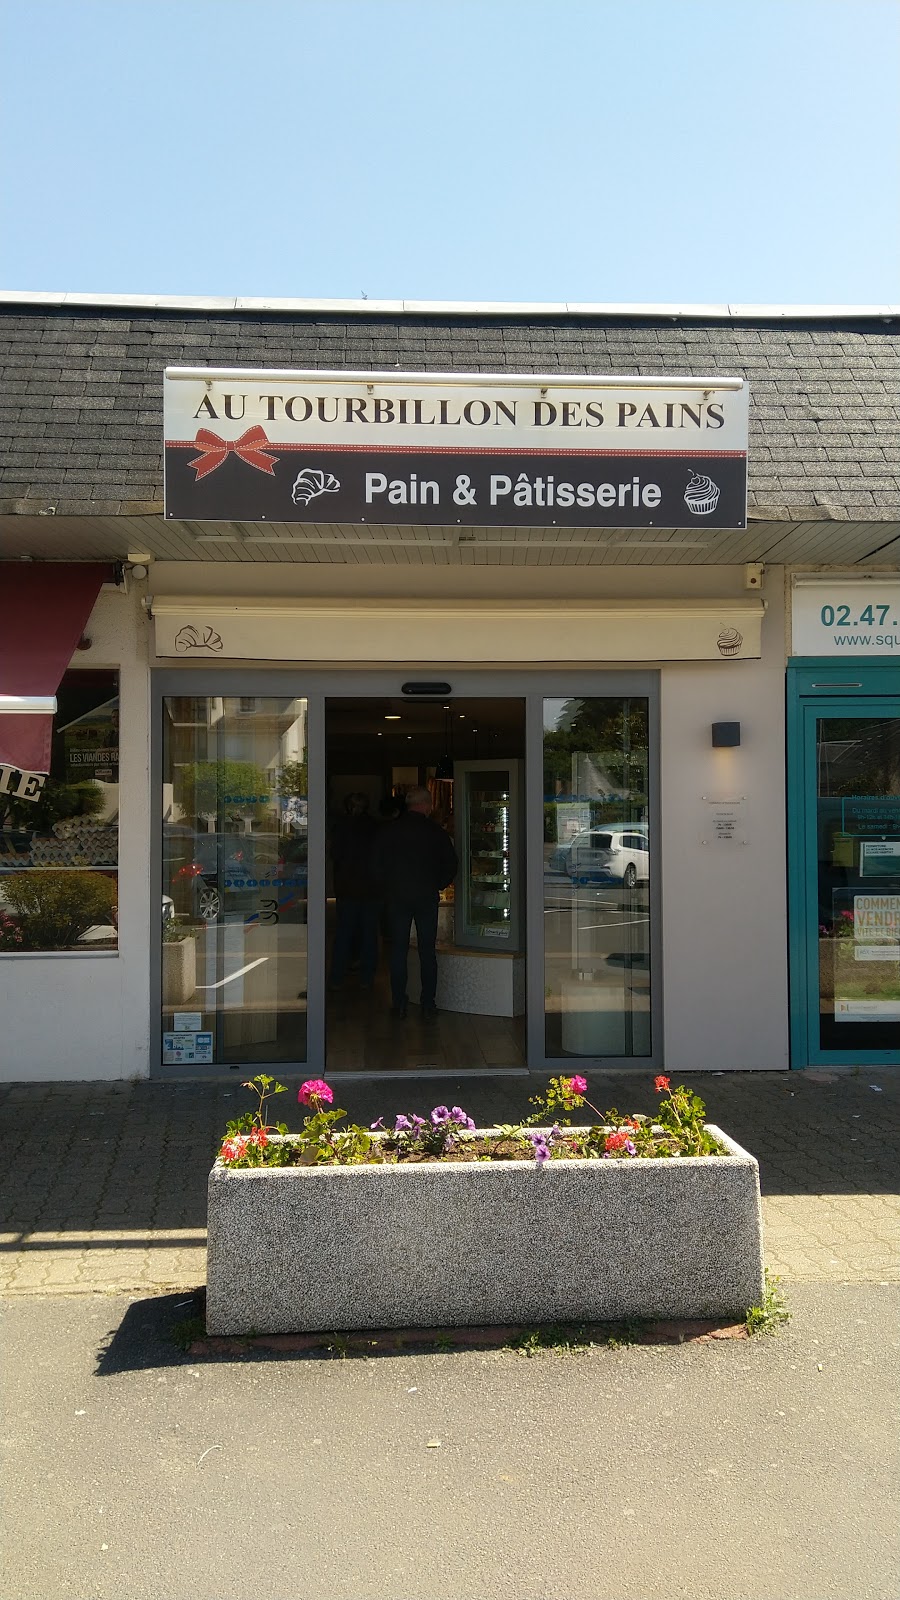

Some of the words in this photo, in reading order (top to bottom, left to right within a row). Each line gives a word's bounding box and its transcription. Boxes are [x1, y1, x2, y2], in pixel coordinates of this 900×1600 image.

[193, 393, 248, 420] AU
[259, 395, 519, 427] TOURBILLON
[531, 401, 605, 428] DES
[615, 402, 725, 430] PAINS
[365, 472, 440, 505] Pain
[452, 474, 477, 506] &
[490, 473, 662, 508] Pâtisserie
[821, 604, 898, 627] 02.47.
[69, 753, 82, 763] LES
[82, 752, 110, 763] VIANDES
[886, 927, 900, 937] BIE
